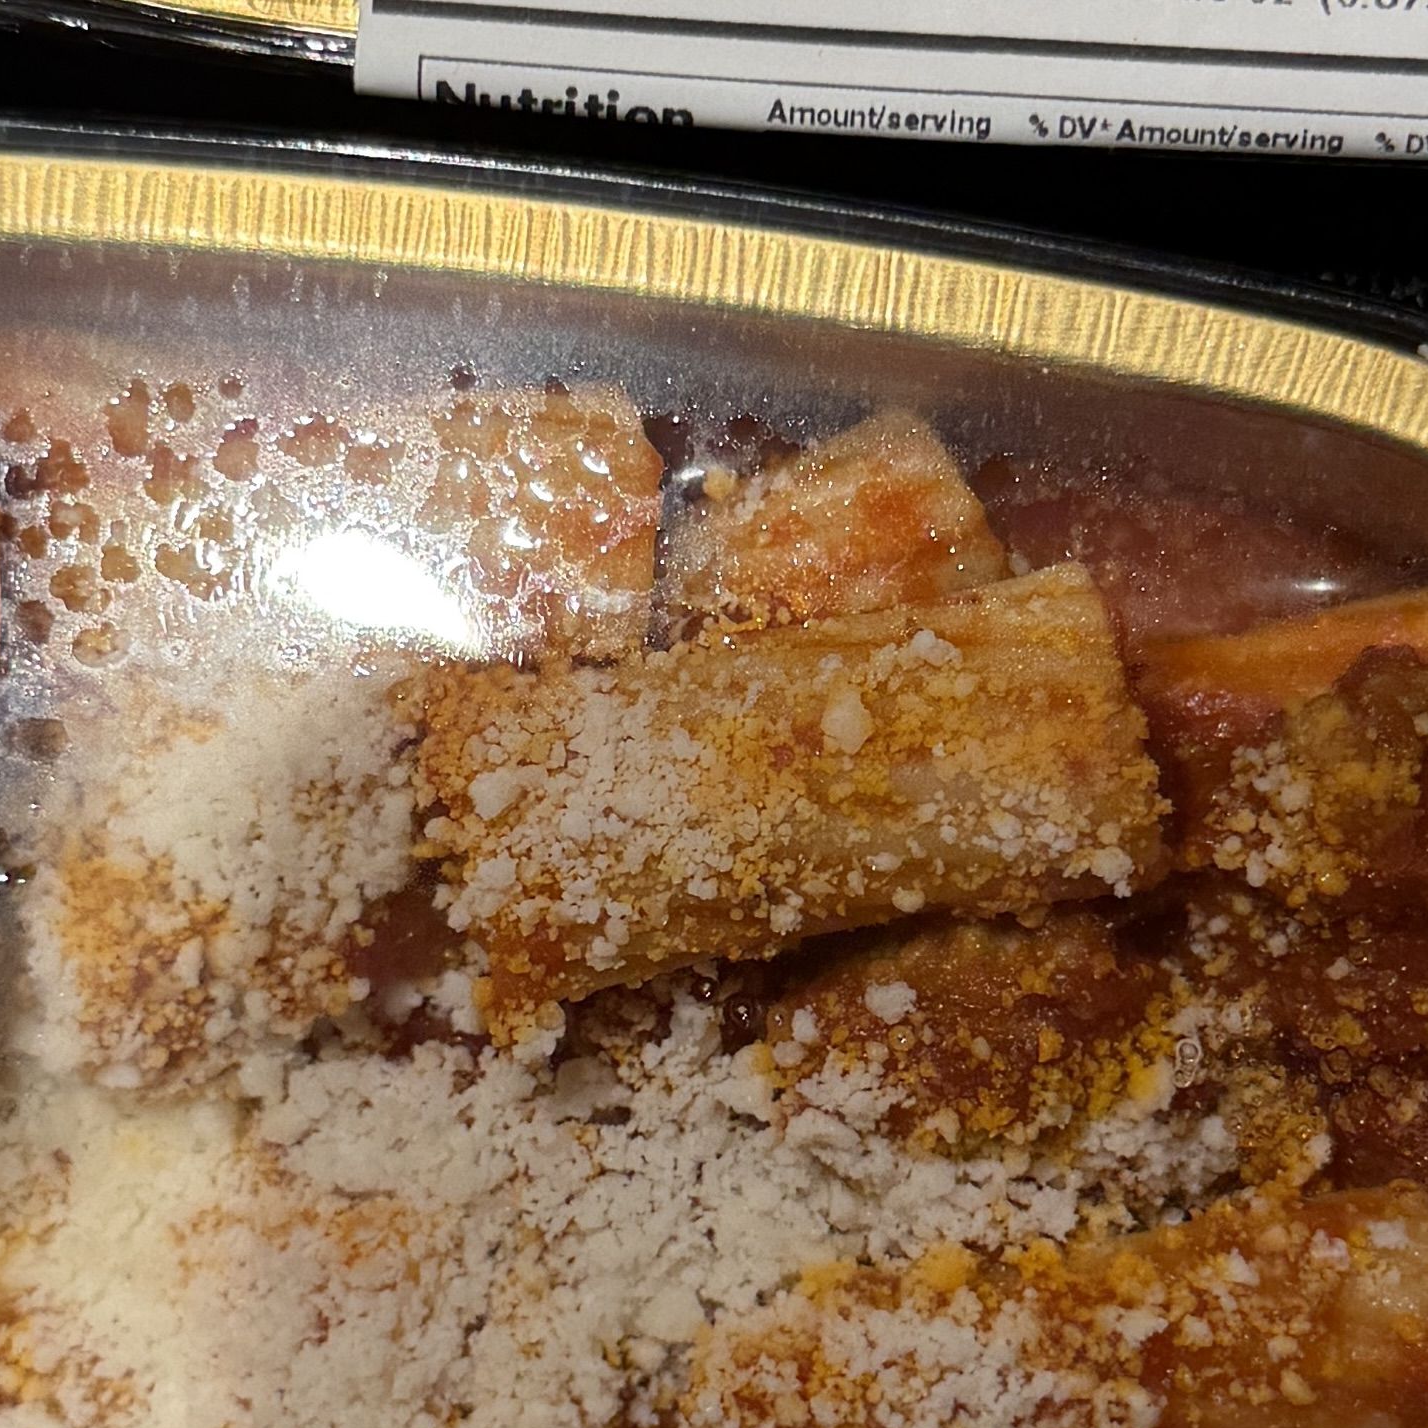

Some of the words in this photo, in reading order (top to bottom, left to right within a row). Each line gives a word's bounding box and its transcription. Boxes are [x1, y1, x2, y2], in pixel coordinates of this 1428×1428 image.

[767, 99, 991, 139] Amount/serving
[1029, 113, 1049, 138] %
[1115, 118, 1343, 154] Amount/serving
[1374, 131, 1395, 152] %
